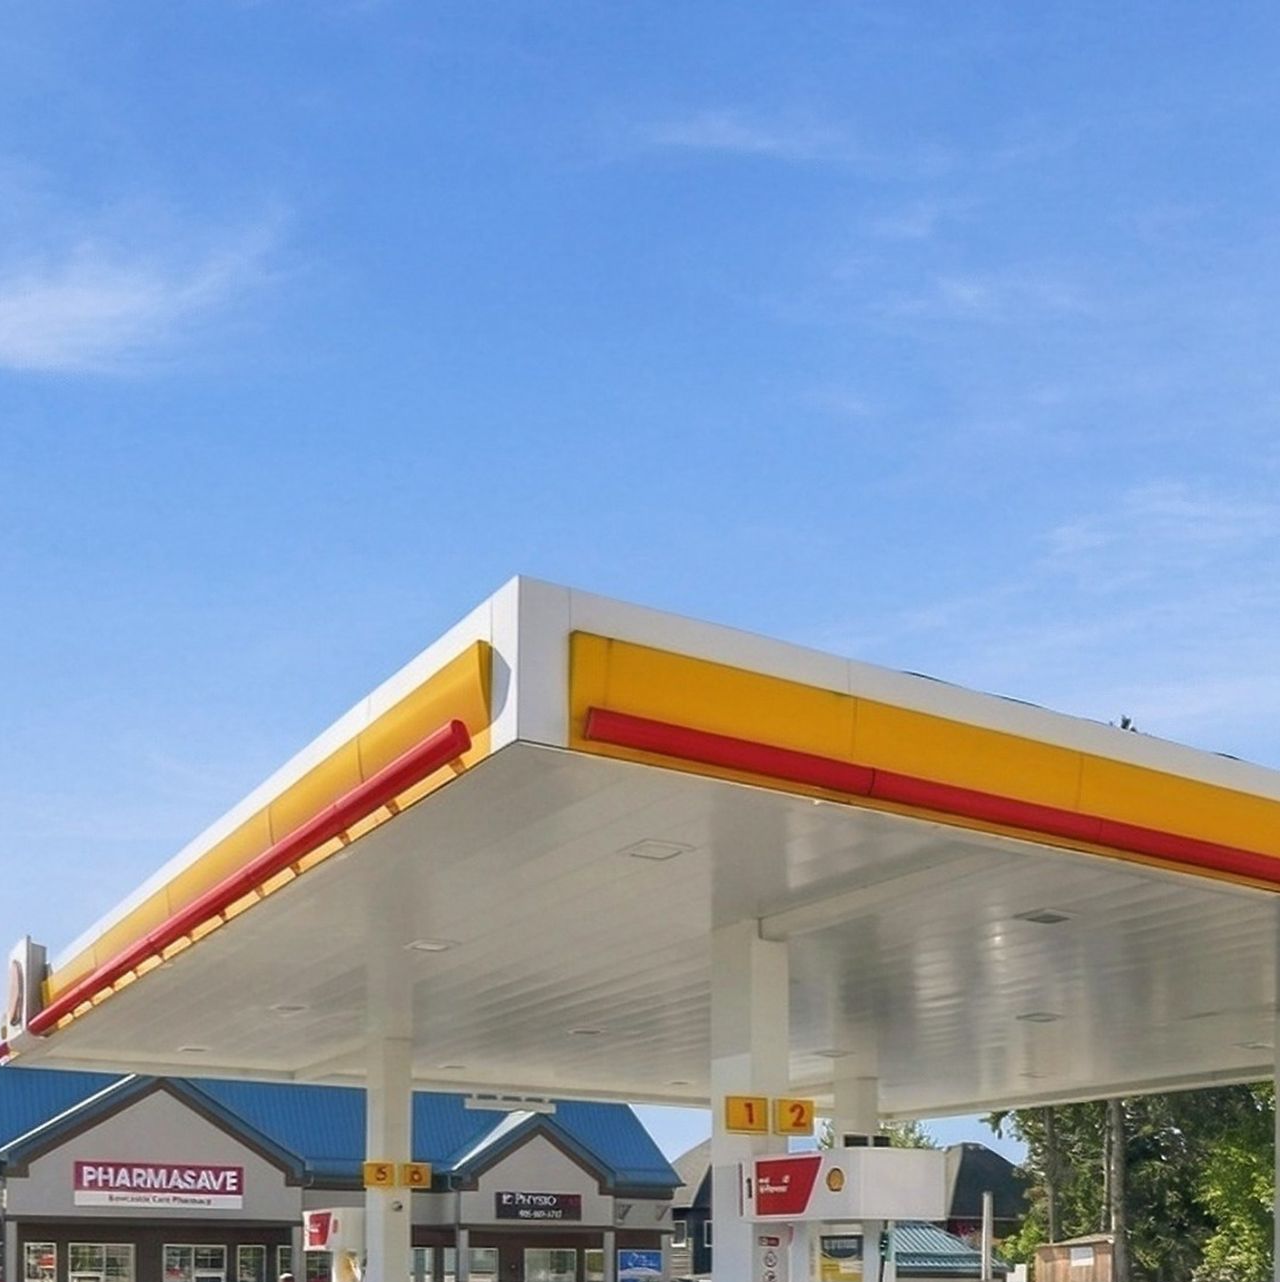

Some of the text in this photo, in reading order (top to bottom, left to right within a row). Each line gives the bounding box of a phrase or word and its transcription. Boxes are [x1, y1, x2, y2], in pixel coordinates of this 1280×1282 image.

[744, 1102, 754, 1126] 1
[789, 1103, 807, 1128] 2
[82, 1165, 238, 1191] PHARMASAVE
[376, 1166, 388, 1182] 5
